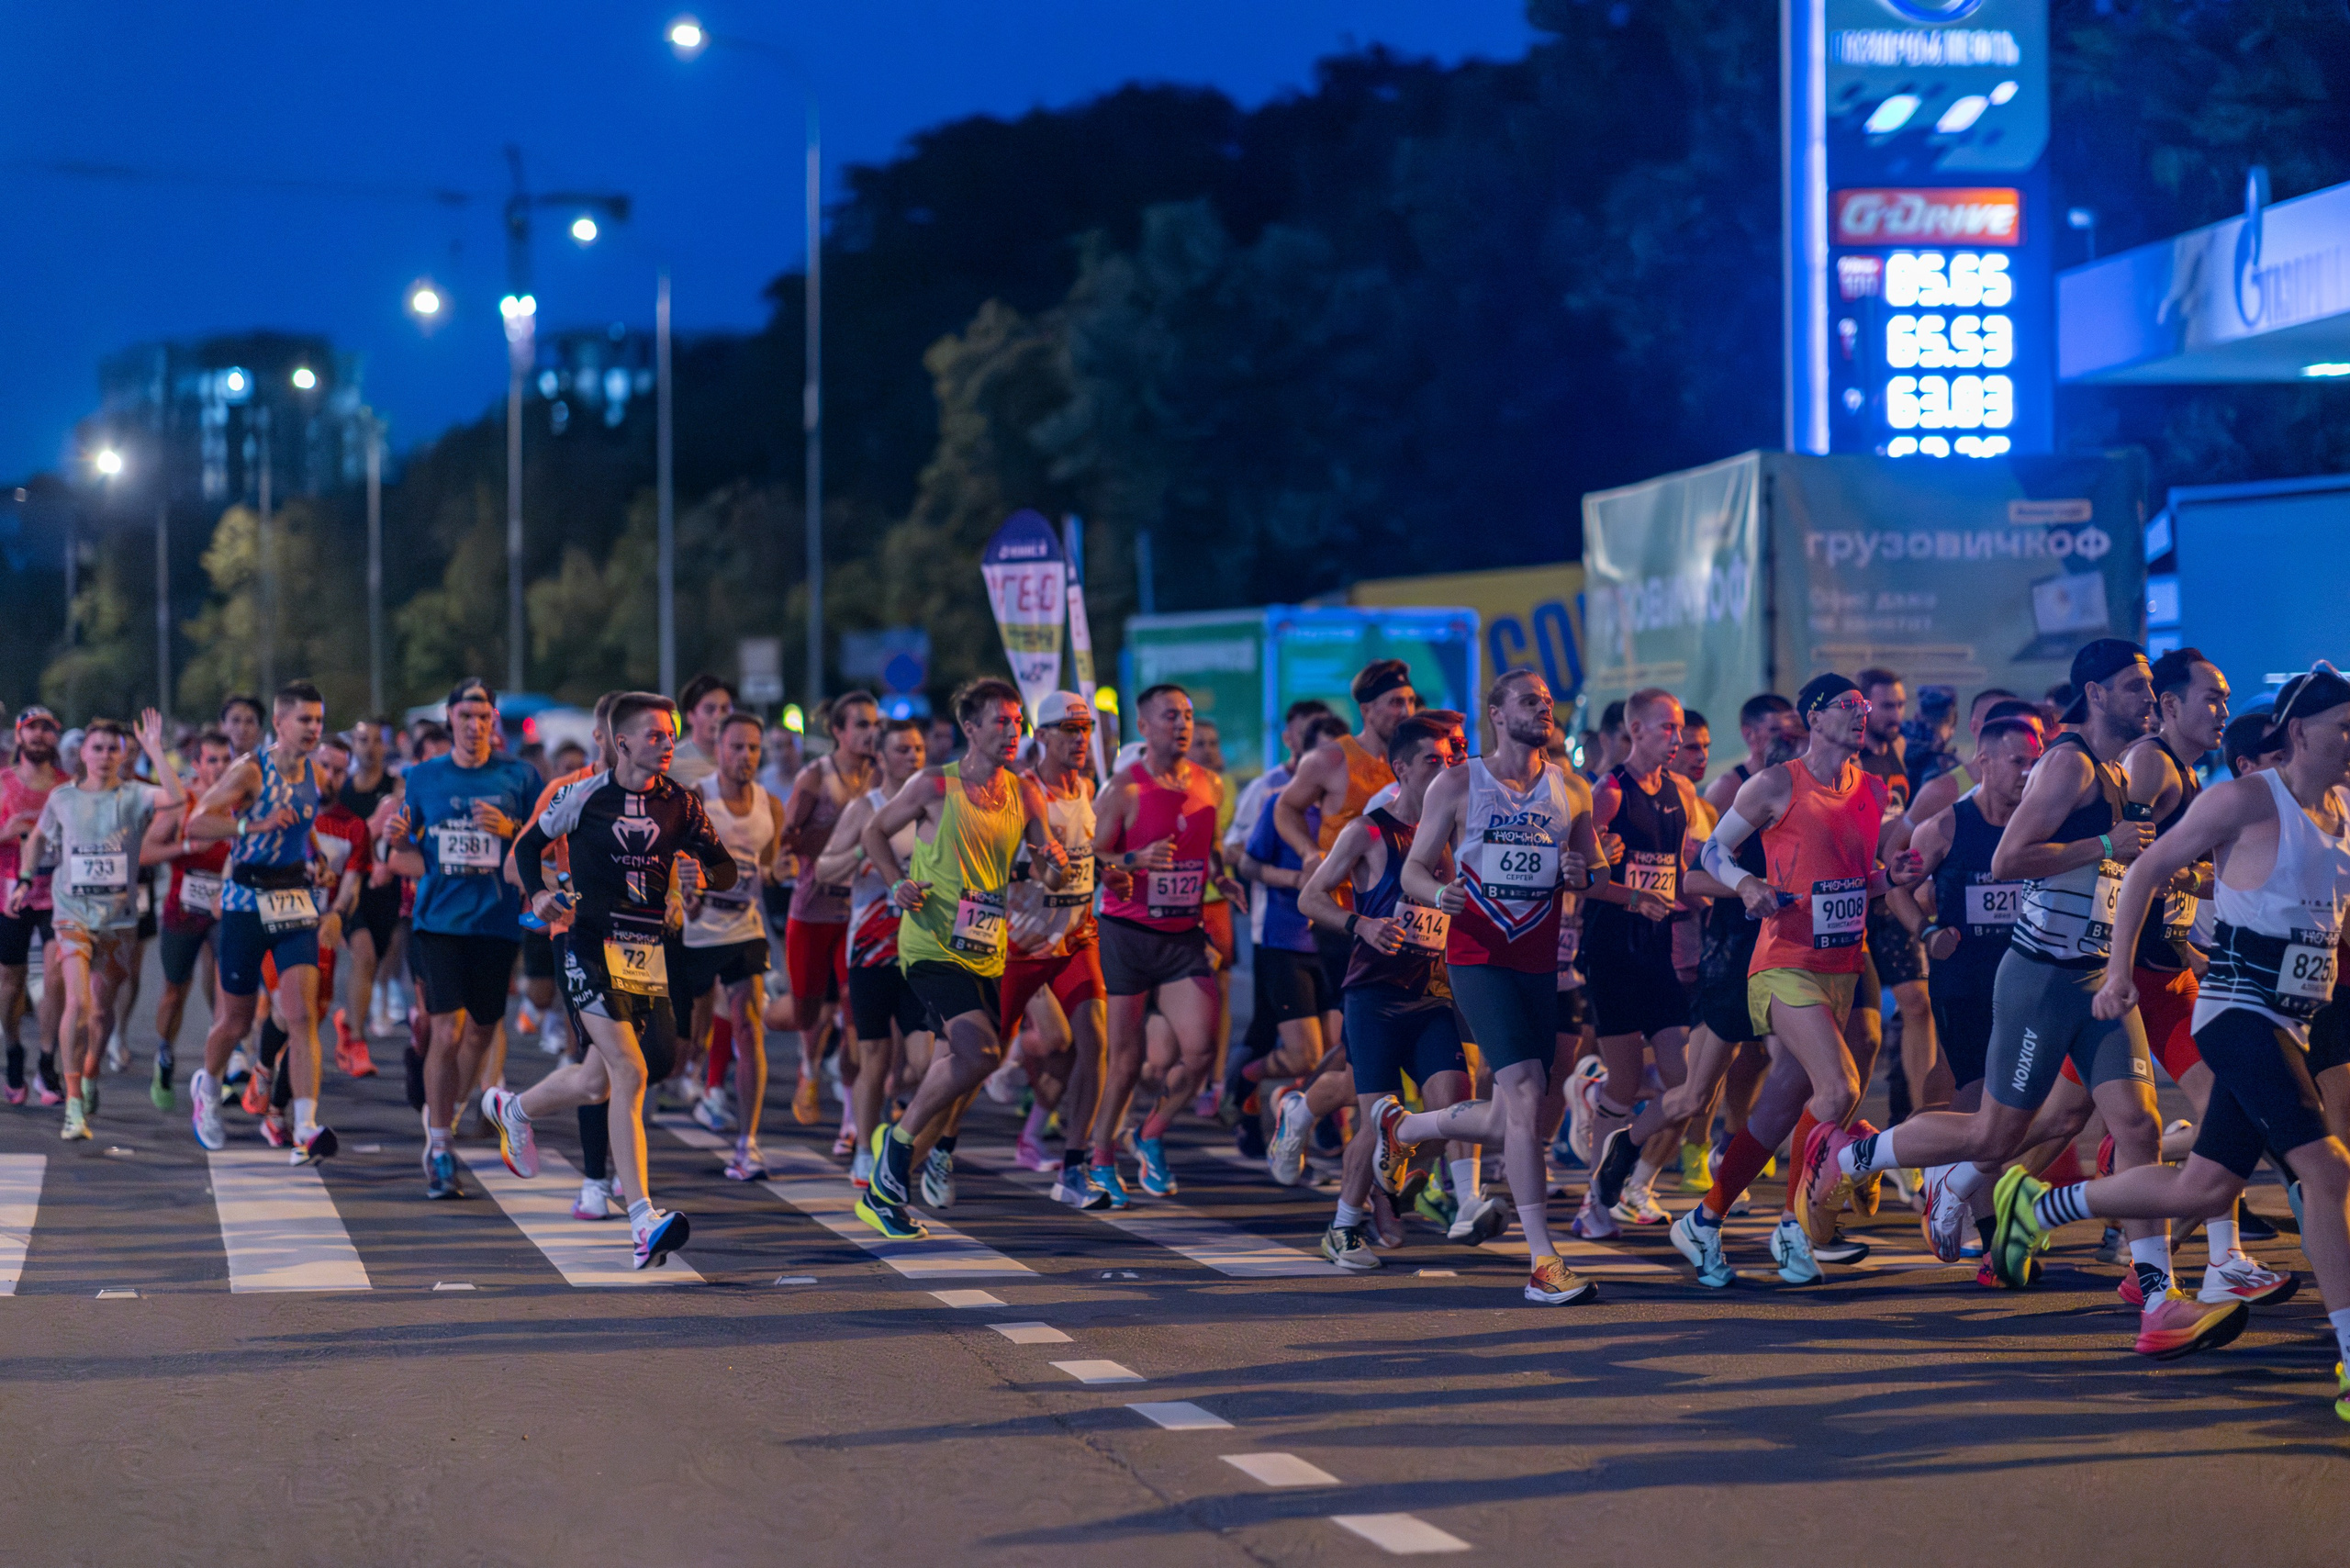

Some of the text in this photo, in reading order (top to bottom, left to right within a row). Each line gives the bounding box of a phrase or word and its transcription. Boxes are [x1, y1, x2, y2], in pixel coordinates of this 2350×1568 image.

[1489, 812, 1552, 829] DUSTY
[447, 835, 490, 855] 2581
[84, 858, 115, 877] 733
[1499, 850, 1542, 873] 628
[1157, 875, 1199, 895] 5127
[1505, 873, 1534, 881] СЕРГЕЙ
[1628, 869, 1674, 890] 17227
[268, 892, 306, 913] 1771
[1822, 896, 1864, 922] 9008
[1983, 890, 2018, 912] 821
[1403, 911, 1444, 936] 9414
[623, 949, 647, 969] 72
[2011, 1026, 2039, 1093] ADIXION
